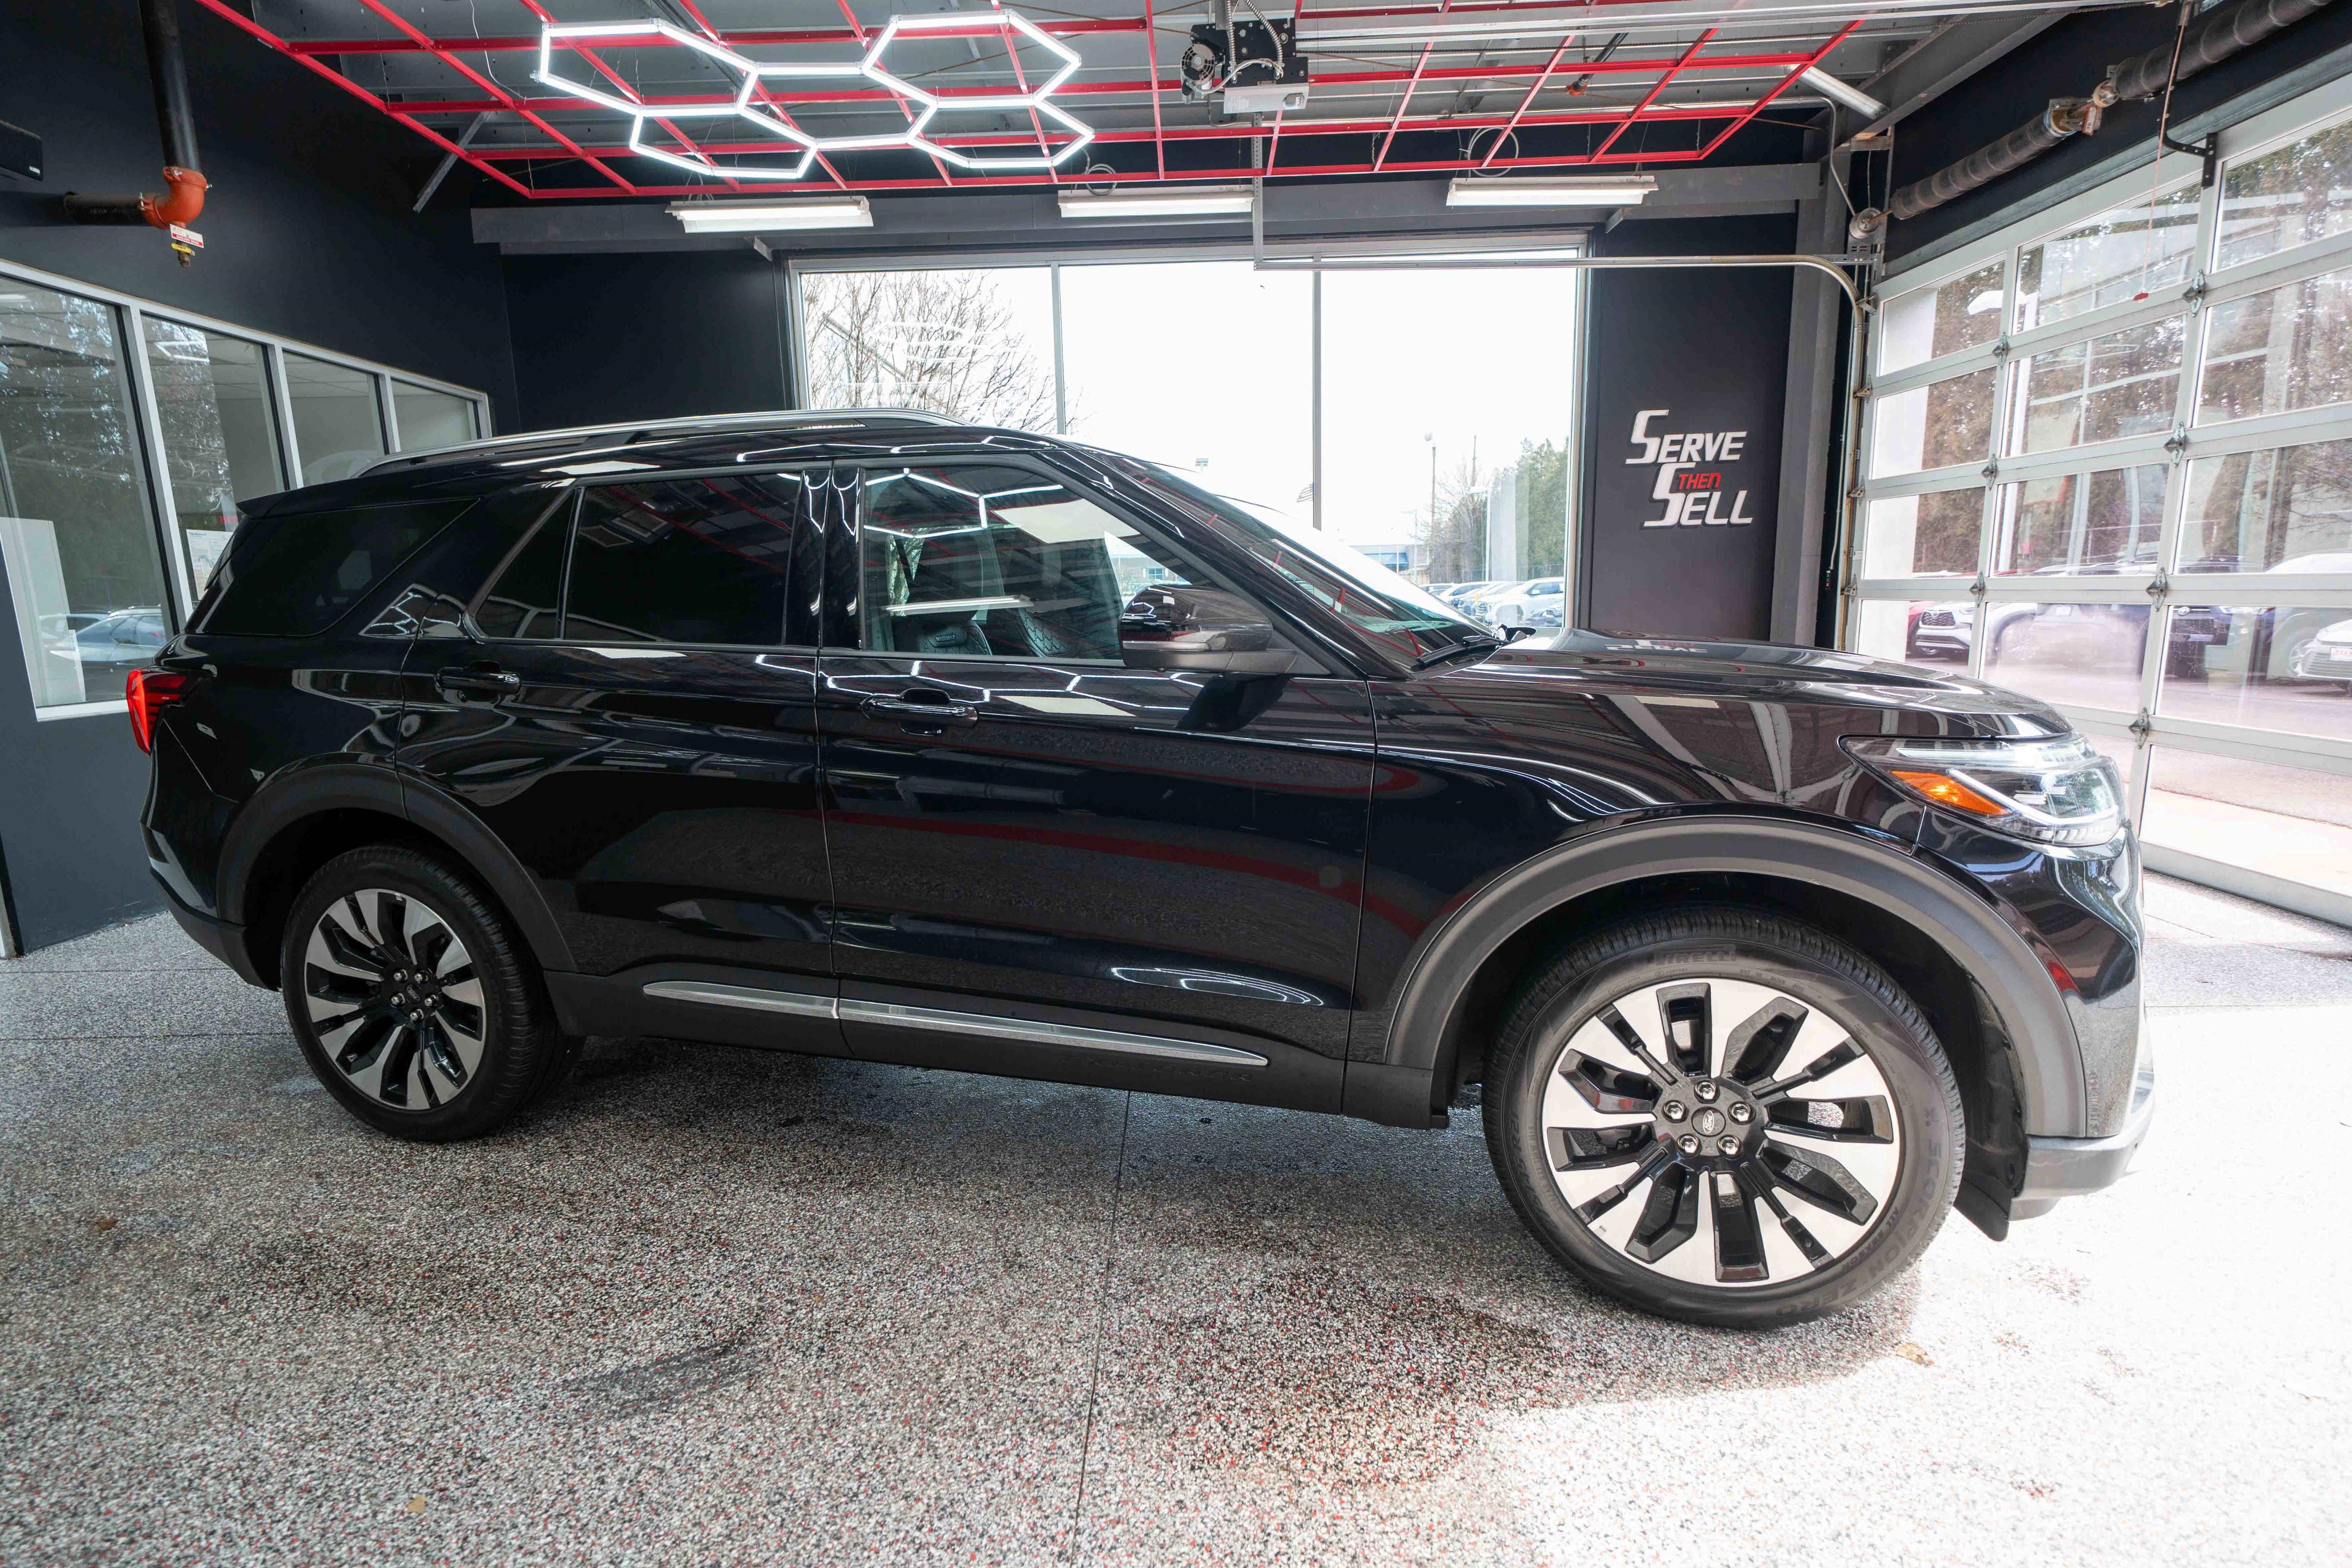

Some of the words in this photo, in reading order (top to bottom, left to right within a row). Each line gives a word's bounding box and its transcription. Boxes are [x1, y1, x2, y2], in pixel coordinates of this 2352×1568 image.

[1625, 410, 1747, 464] SERVE
[1643, 462, 1753, 527] SELL
[1704, 1114, 1713, 1131] Ford
